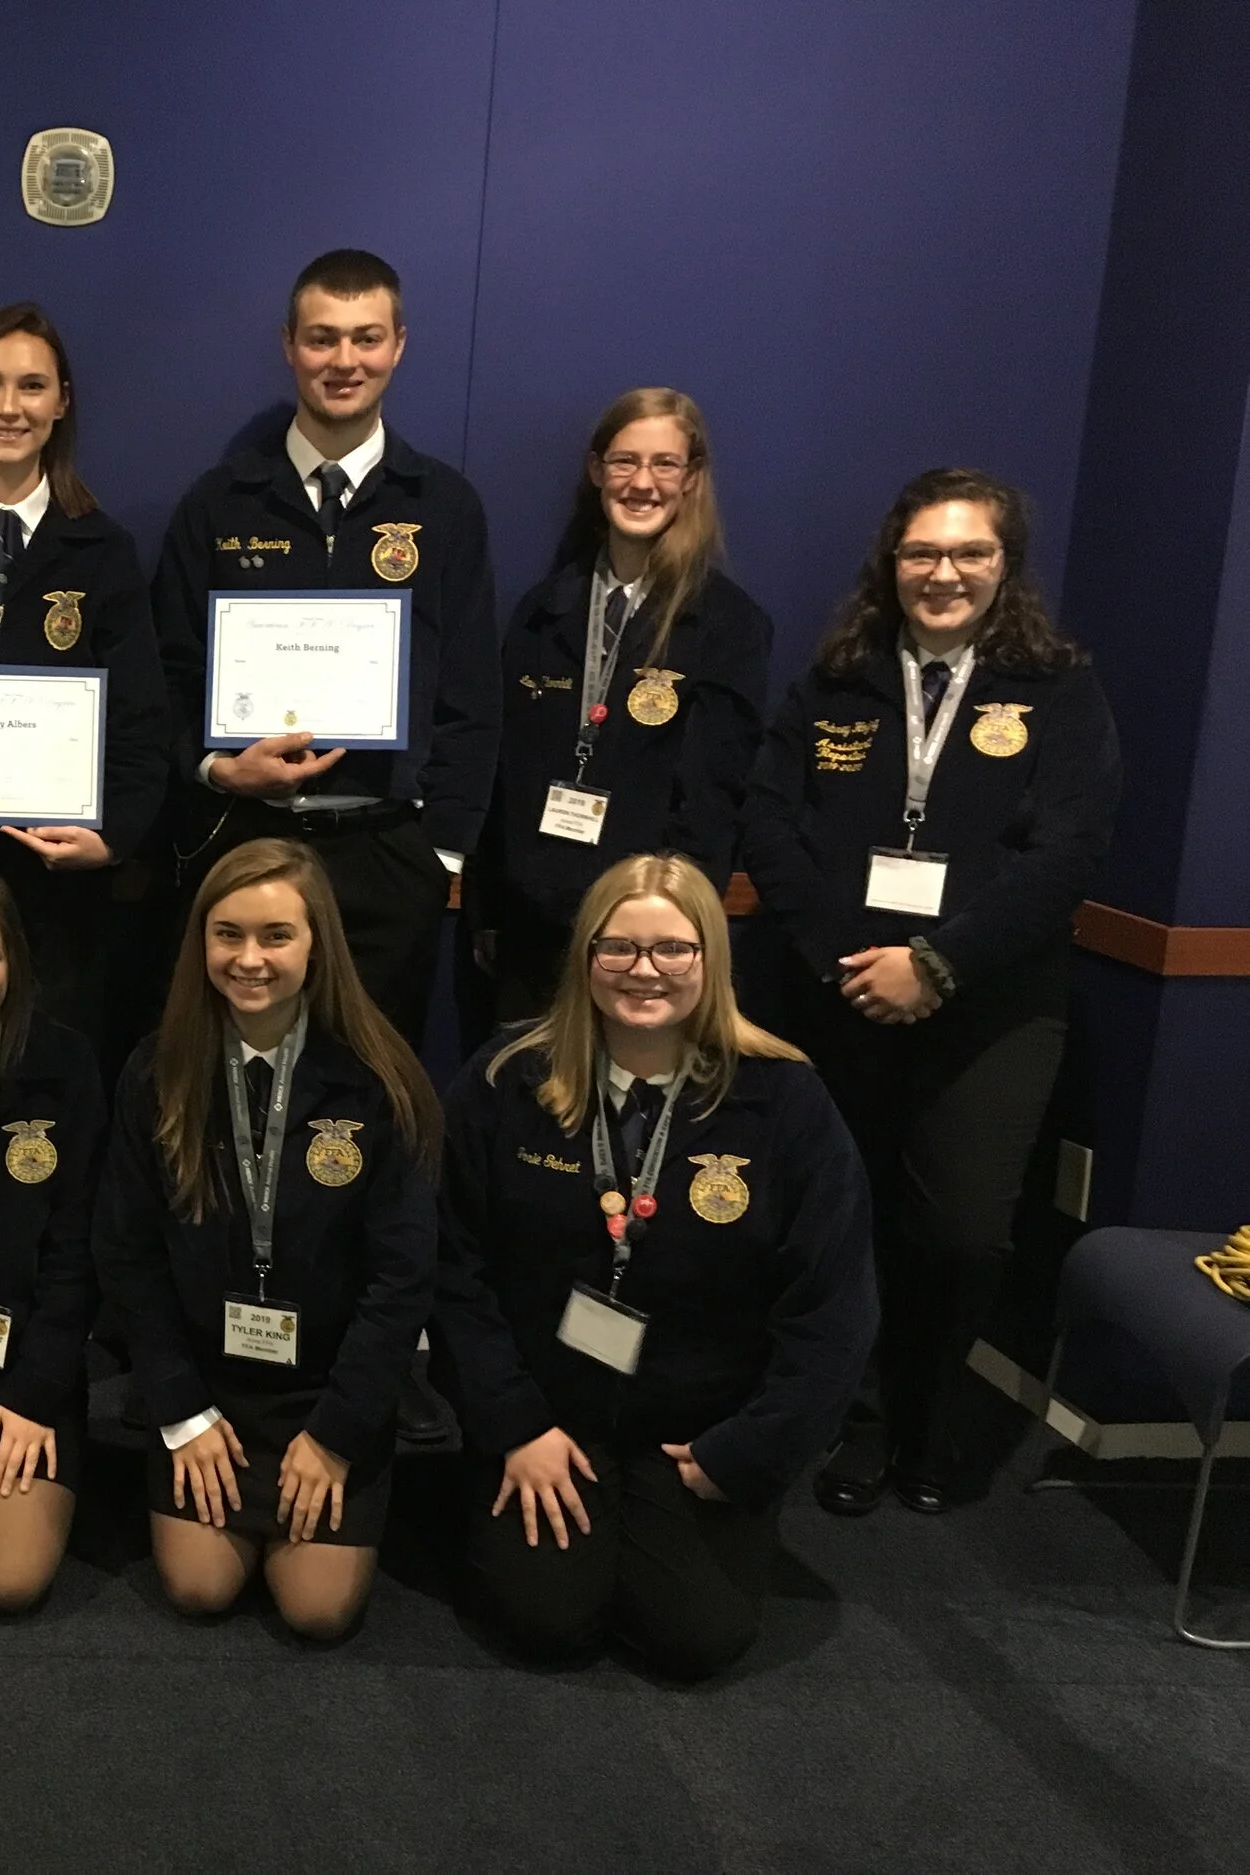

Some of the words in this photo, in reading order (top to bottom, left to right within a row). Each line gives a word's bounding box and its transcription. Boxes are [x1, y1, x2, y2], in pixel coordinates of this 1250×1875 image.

[275, 643, 301, 652] Keith
[303, 643, 340, 654] Berning
[7, 719, 37, 729] Albers
[250, 1313, 271, 1324] 2019
[231, 1323, 263, 1337] TYLER
[265, 1330, 291, 1342] KING
